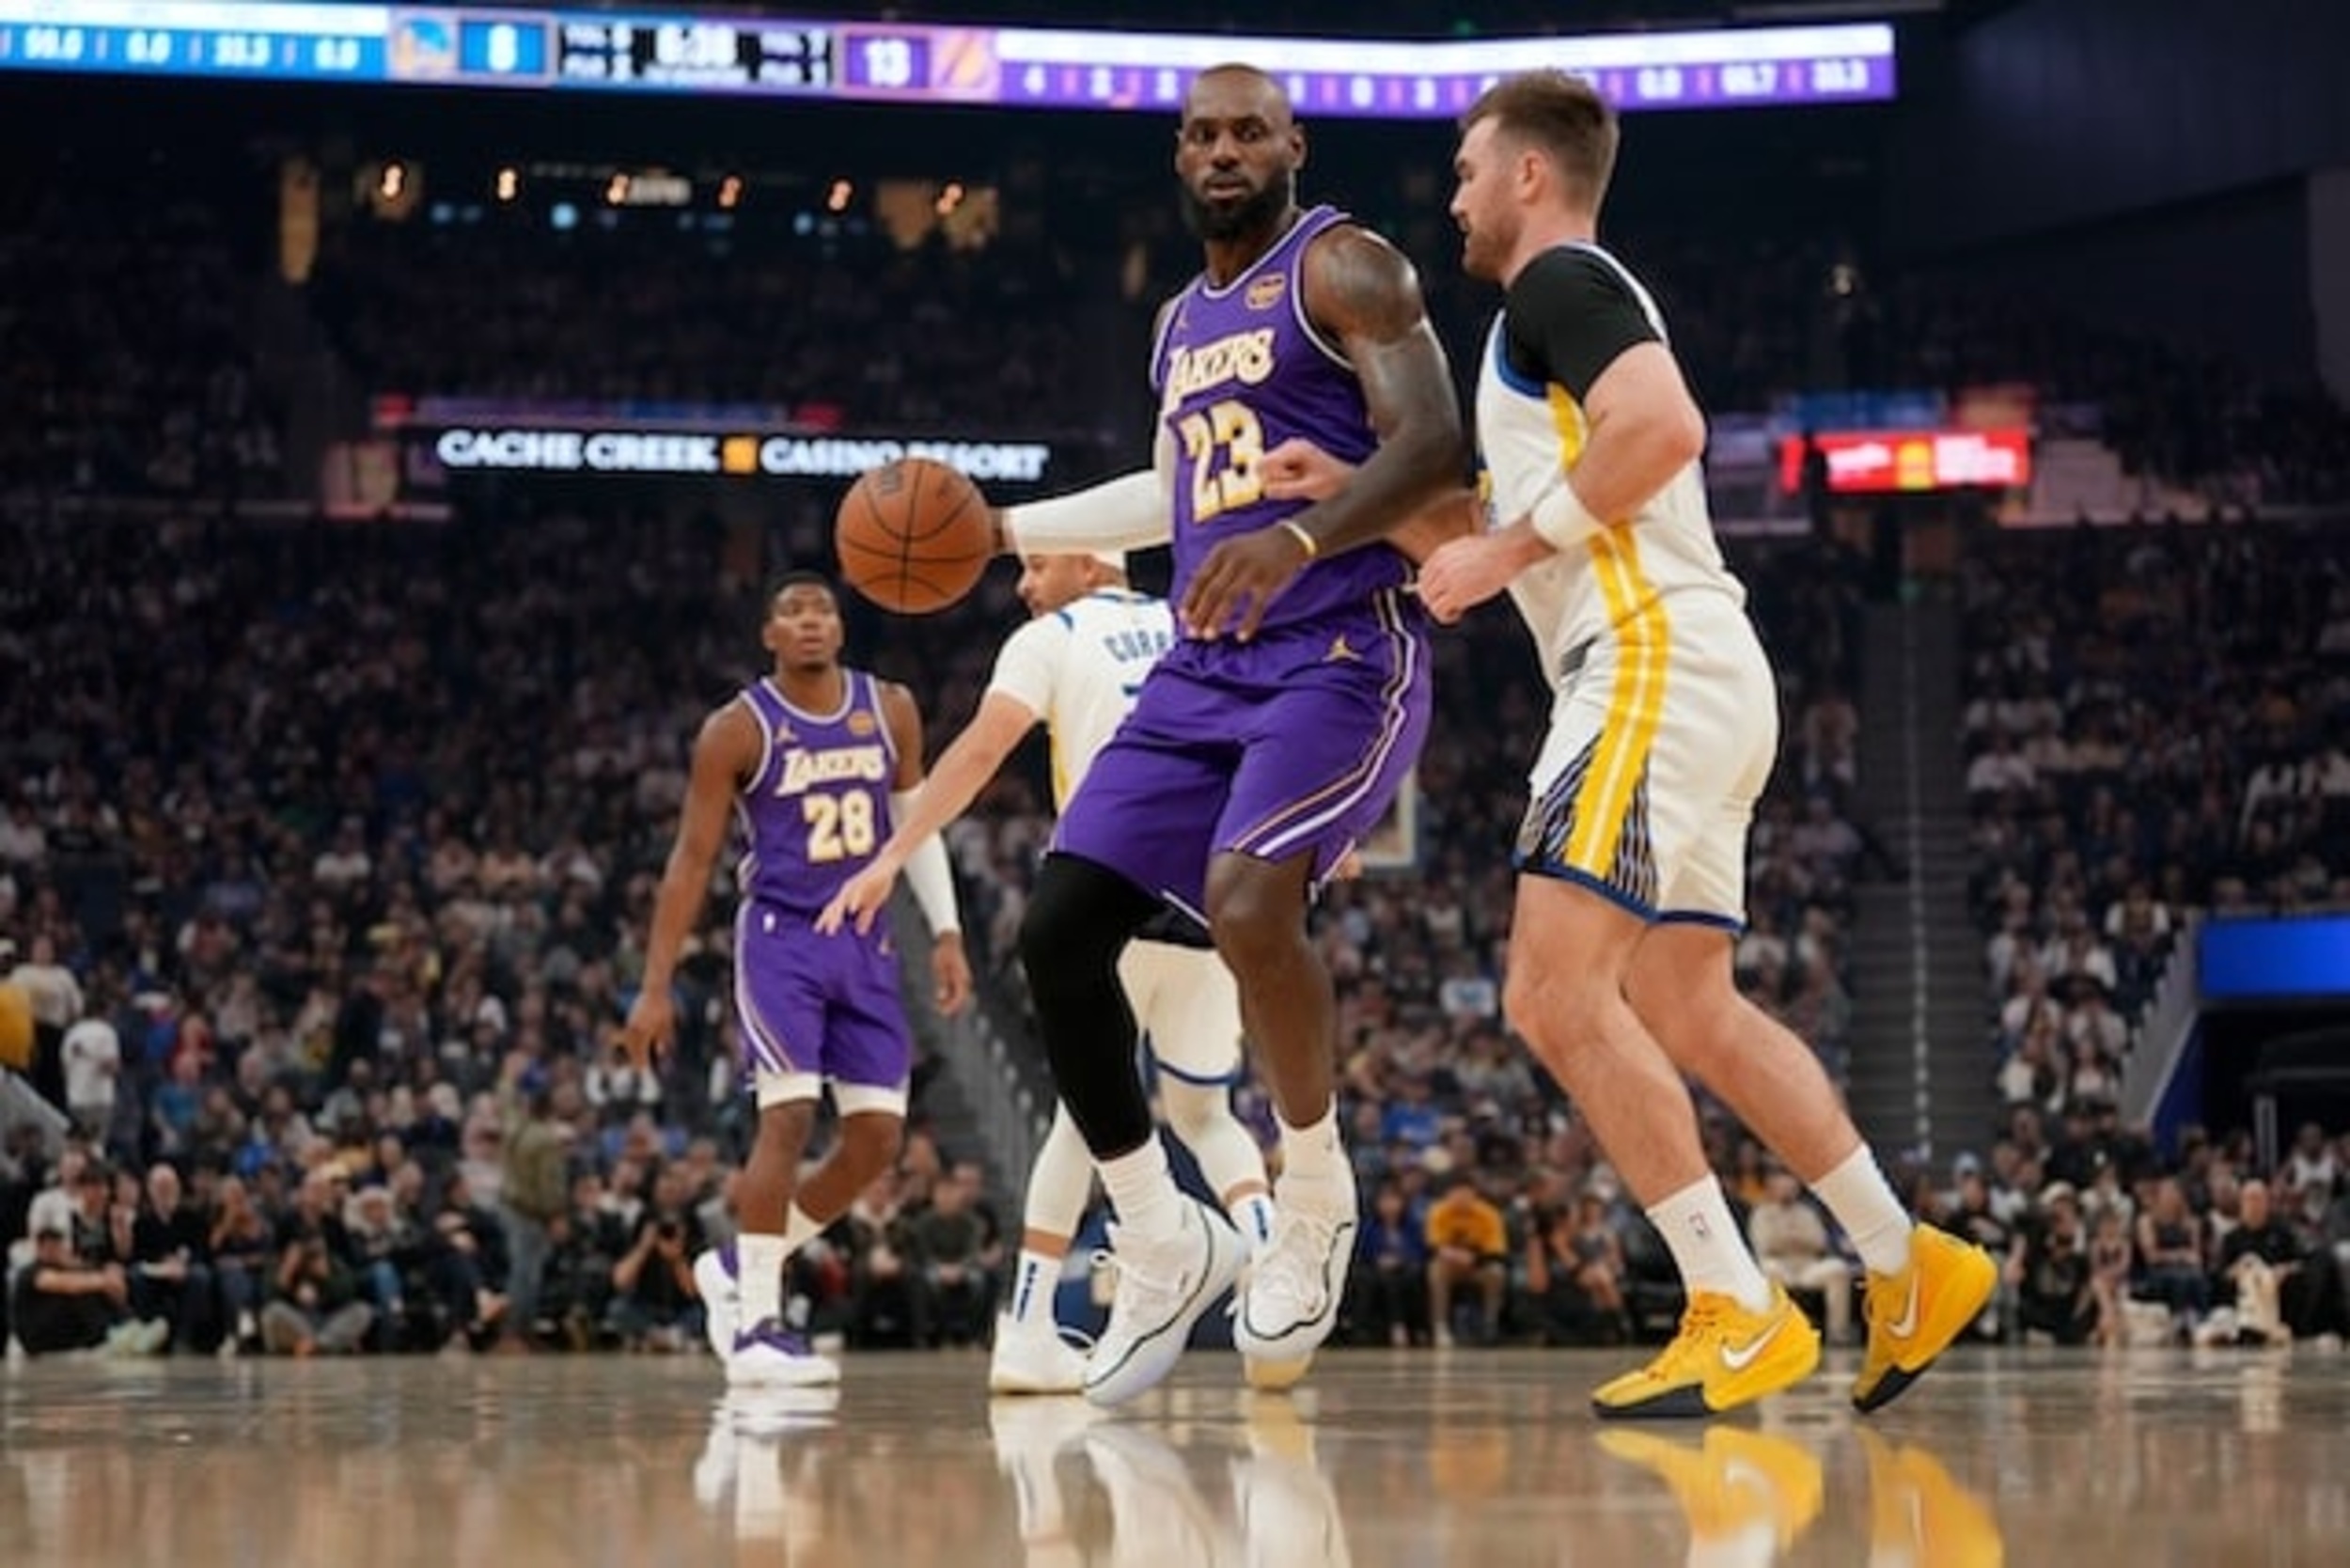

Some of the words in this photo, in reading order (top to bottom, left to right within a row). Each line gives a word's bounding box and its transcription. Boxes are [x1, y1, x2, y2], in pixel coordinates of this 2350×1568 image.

[1178, 399, 1266, 523] 23
[775, 744, 885, 797] LAKERS
[803, 788, 875, 864] 28
